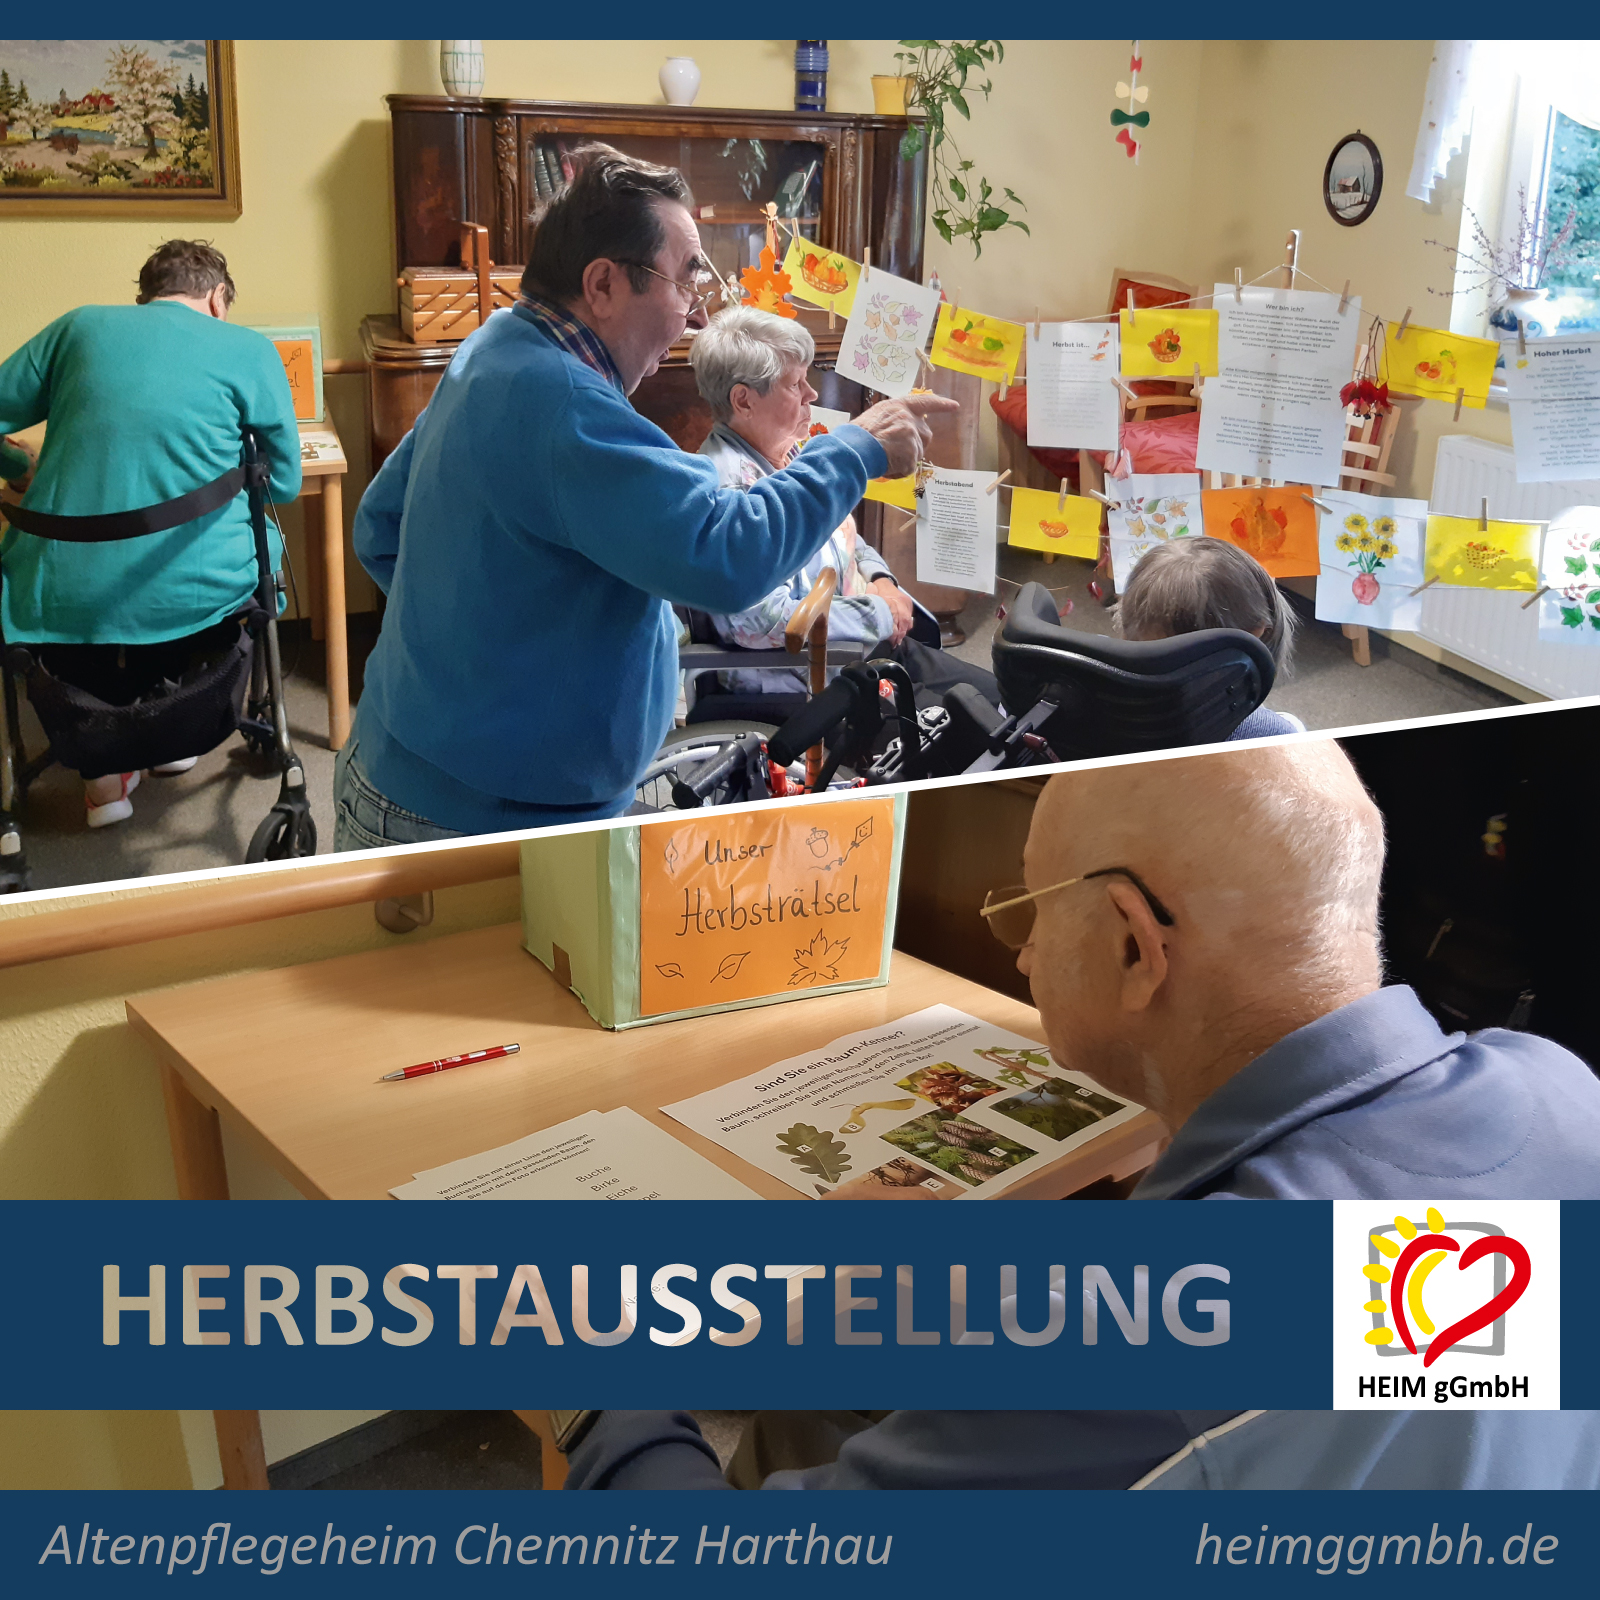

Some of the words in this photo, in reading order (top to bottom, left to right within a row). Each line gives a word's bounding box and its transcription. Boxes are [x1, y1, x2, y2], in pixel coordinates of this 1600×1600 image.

[1533, 350, 1561, 358] Hoher
[1562, 347, 1592, 355] Herbst
[934, 479, 974, 488] Herbstabend
[704, 839, 774, 866] Unser
[675, 874, 861, 937] Herbsträtsel
[715, 1102, 765, 1123] Verbinden
[762, 1096, 779, 1105] Sie
[778, 1089, 796, 1099] den
[795, 1071, 837, 1092] jeweiligen
[834, 1051, 881, 1074] Buchstaben
[880, 1046, 894, 1055] mit
[893, 1042, 911, 1050] dem
[927, 1022, 965, 1040] passenden
[754, 1076, 787, 1093] Sind
[783, 1067, 808, 1079] Sie
[806, 1060, 828, 1070] ein
[824, 1030, 906, 1064] Baum-Kenner?
[721, 1119, 755, 1133] Baum,
[752, 1100, 797, 1121] schreiben
[794, 1093, 812, 1102] Sie
[809, 1083, 832, 1096] Ihren
[831, 1072, 862, 1086] Namen
[860, 1067, 875, 1075] auf
[874, 1058, 890, 1069] den
[811, 1096, 829, 1107] und
[828, 1079, 873, 1099] schmeißen
[870, 1073, 886, 1081] Sie
[884, 1065, 898, 1076] ihn
[897, 1060, 907, 1068] in
[848, 1123, 859, 1131] B
[436, 1178, 478, 1195] Verbinden
[490, 1167, 505, 1175] mit
[504, 1159, 523, 1169] einer
[522, 1152, 542, 1161] Linie
[554, 1133, 589, 1149] jeweiligen
[444, 1180, 491, 1200] Buchstaben
[505, 1167, 522, 1176] dem
[522, 1152, 561, 1170] passenden
[559, 1144, 584, 1154] Baum,
[467, 1192, 481, 1200] Sie
[481, 1186, 495, 1194] auf
[494, 1180, 513, 1189] dem
[512, 1172, 530, 1182] Foto
[530, 1158, 563, 1174] erkennen
[575, 1165, 612, 1183] Buche
[590, 1177, 620, 1192] Birke
[605, 1185, 638, 1200] Eiche
[926, 1180, 939, 1189] E
